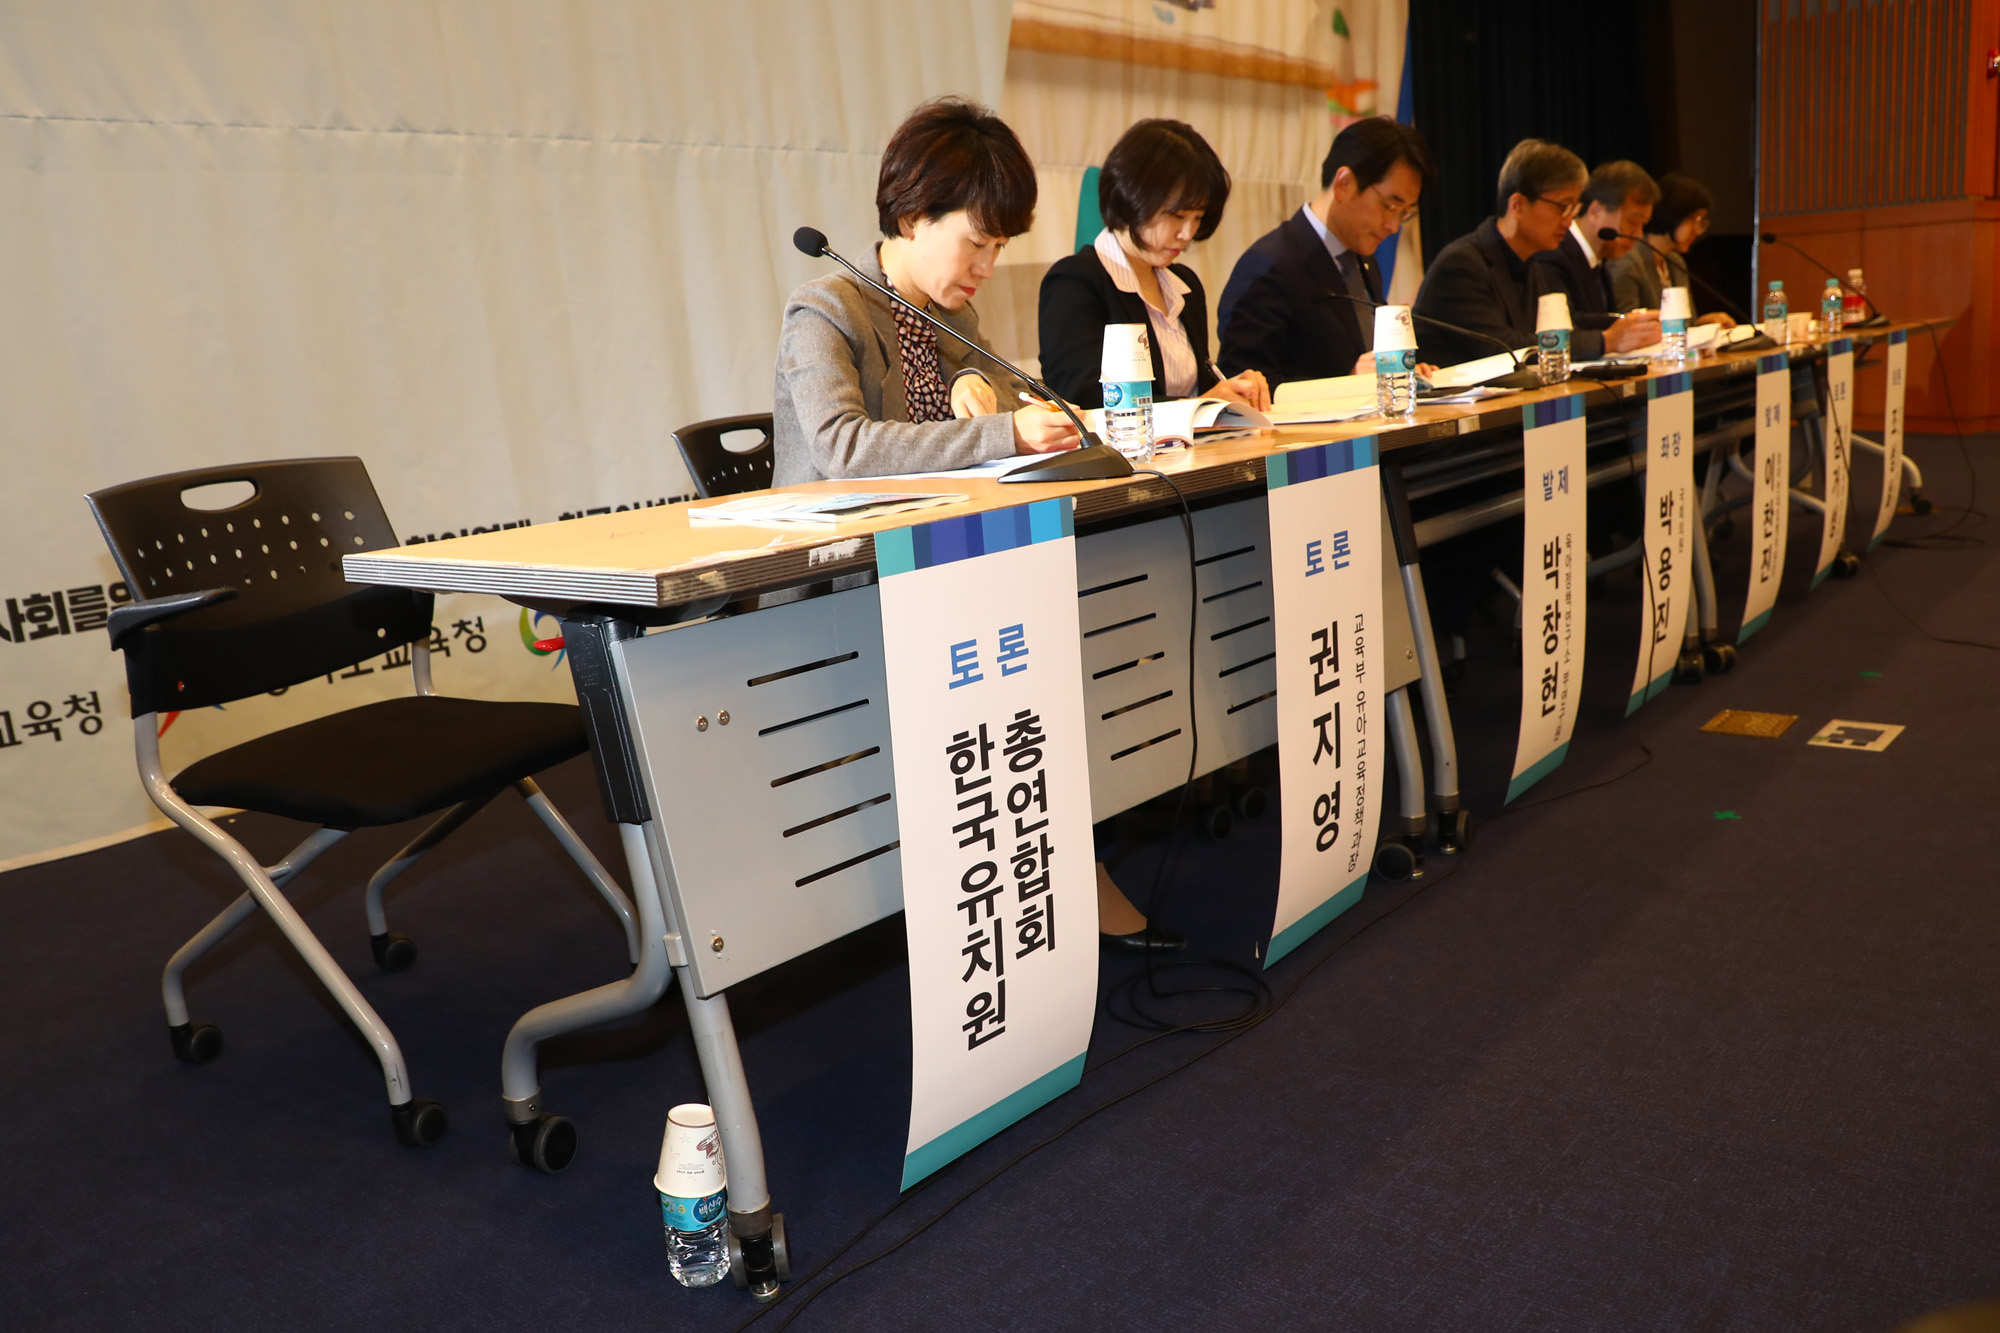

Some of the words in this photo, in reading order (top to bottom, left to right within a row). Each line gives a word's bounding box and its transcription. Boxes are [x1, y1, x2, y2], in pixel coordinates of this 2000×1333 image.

[1542, 464, 1569, 501] 발제
[1304, 530, 1352, 577] 토론
[1656, 489, 1674, 645] 박용진
[948, 622, 1030, 691] 토론
[1354, 613, 1365, 684] 교육부
[1541, 535, 1561, 718] 박창현
[1308, 620, 1341, 853] 권지영
[945, 722, 1006, 1052] 한국유치원
[1002, 708, 1057, 960] 총연합회
[698, 1196, 723, 1215] 백산수
